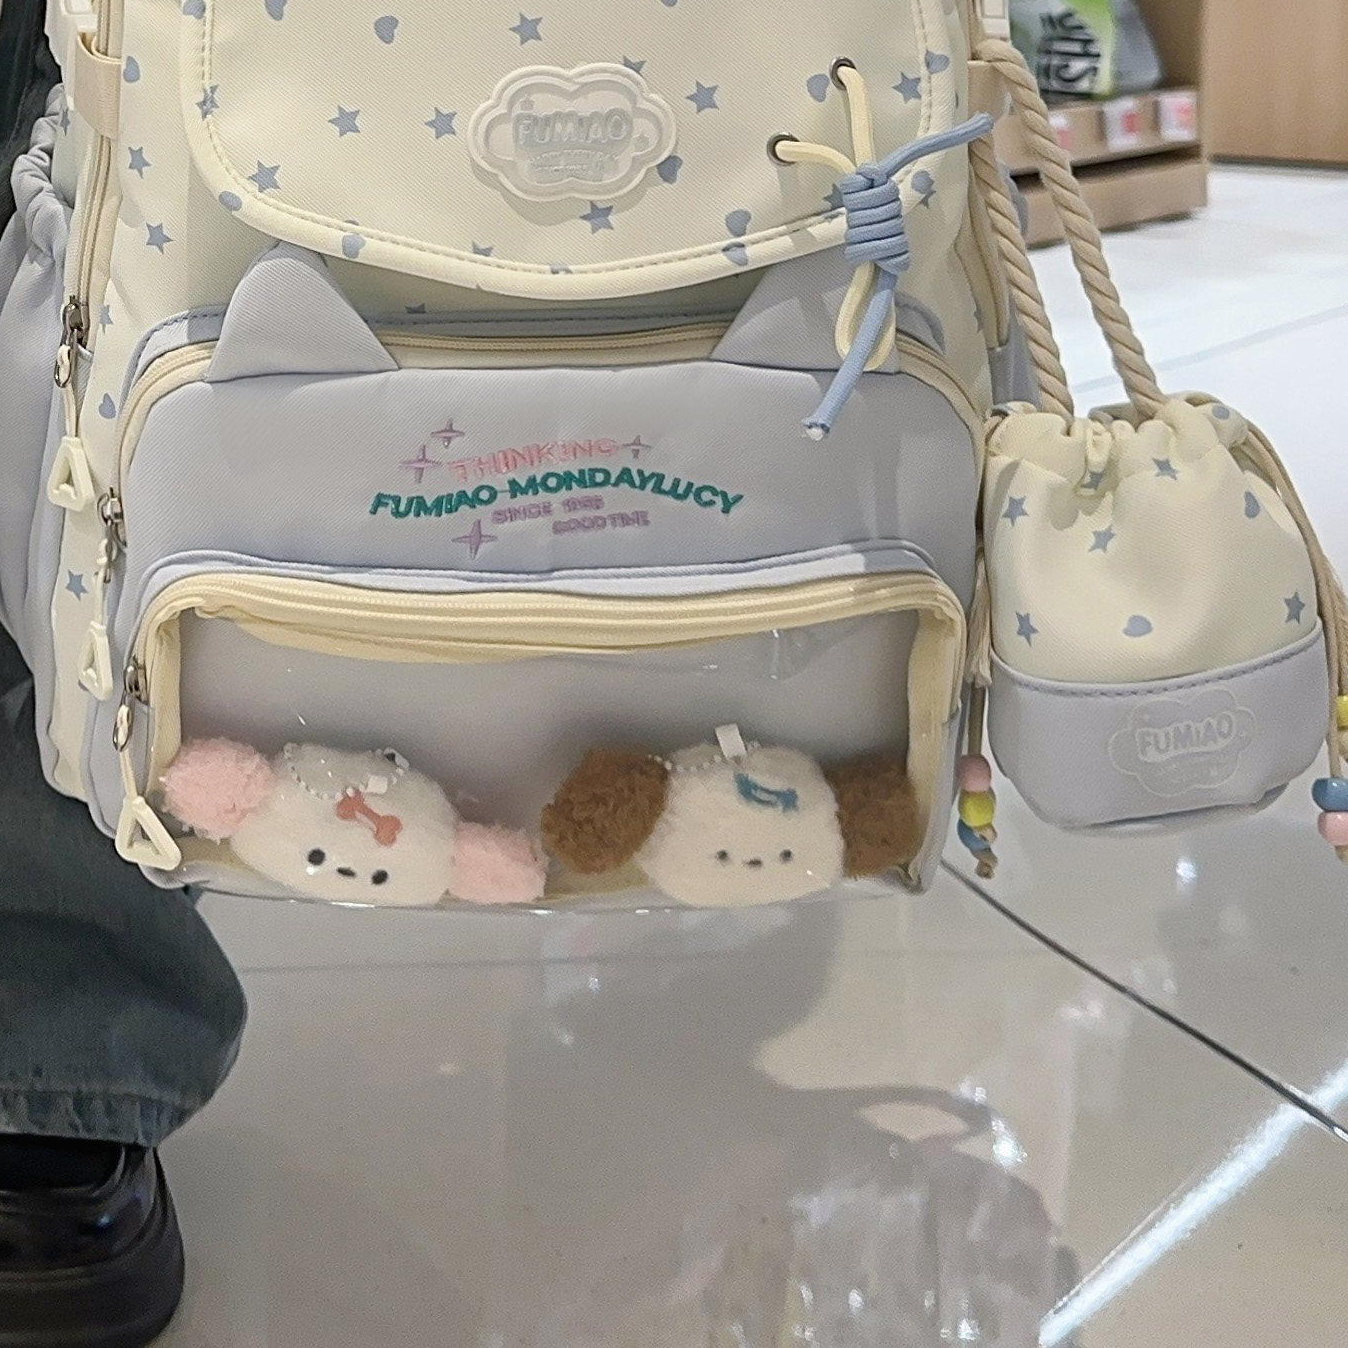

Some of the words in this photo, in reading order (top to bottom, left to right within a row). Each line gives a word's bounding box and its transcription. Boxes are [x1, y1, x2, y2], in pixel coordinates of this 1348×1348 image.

[449, 438, 618, 481] THINKING
[369, 484, 497, 519] FUMIAO
[507, 466, 744, 515] MONDAYLUCY
[491, 500, 552, 525] SINCE
[1139, 712, 1234, 759] FUMIAO
